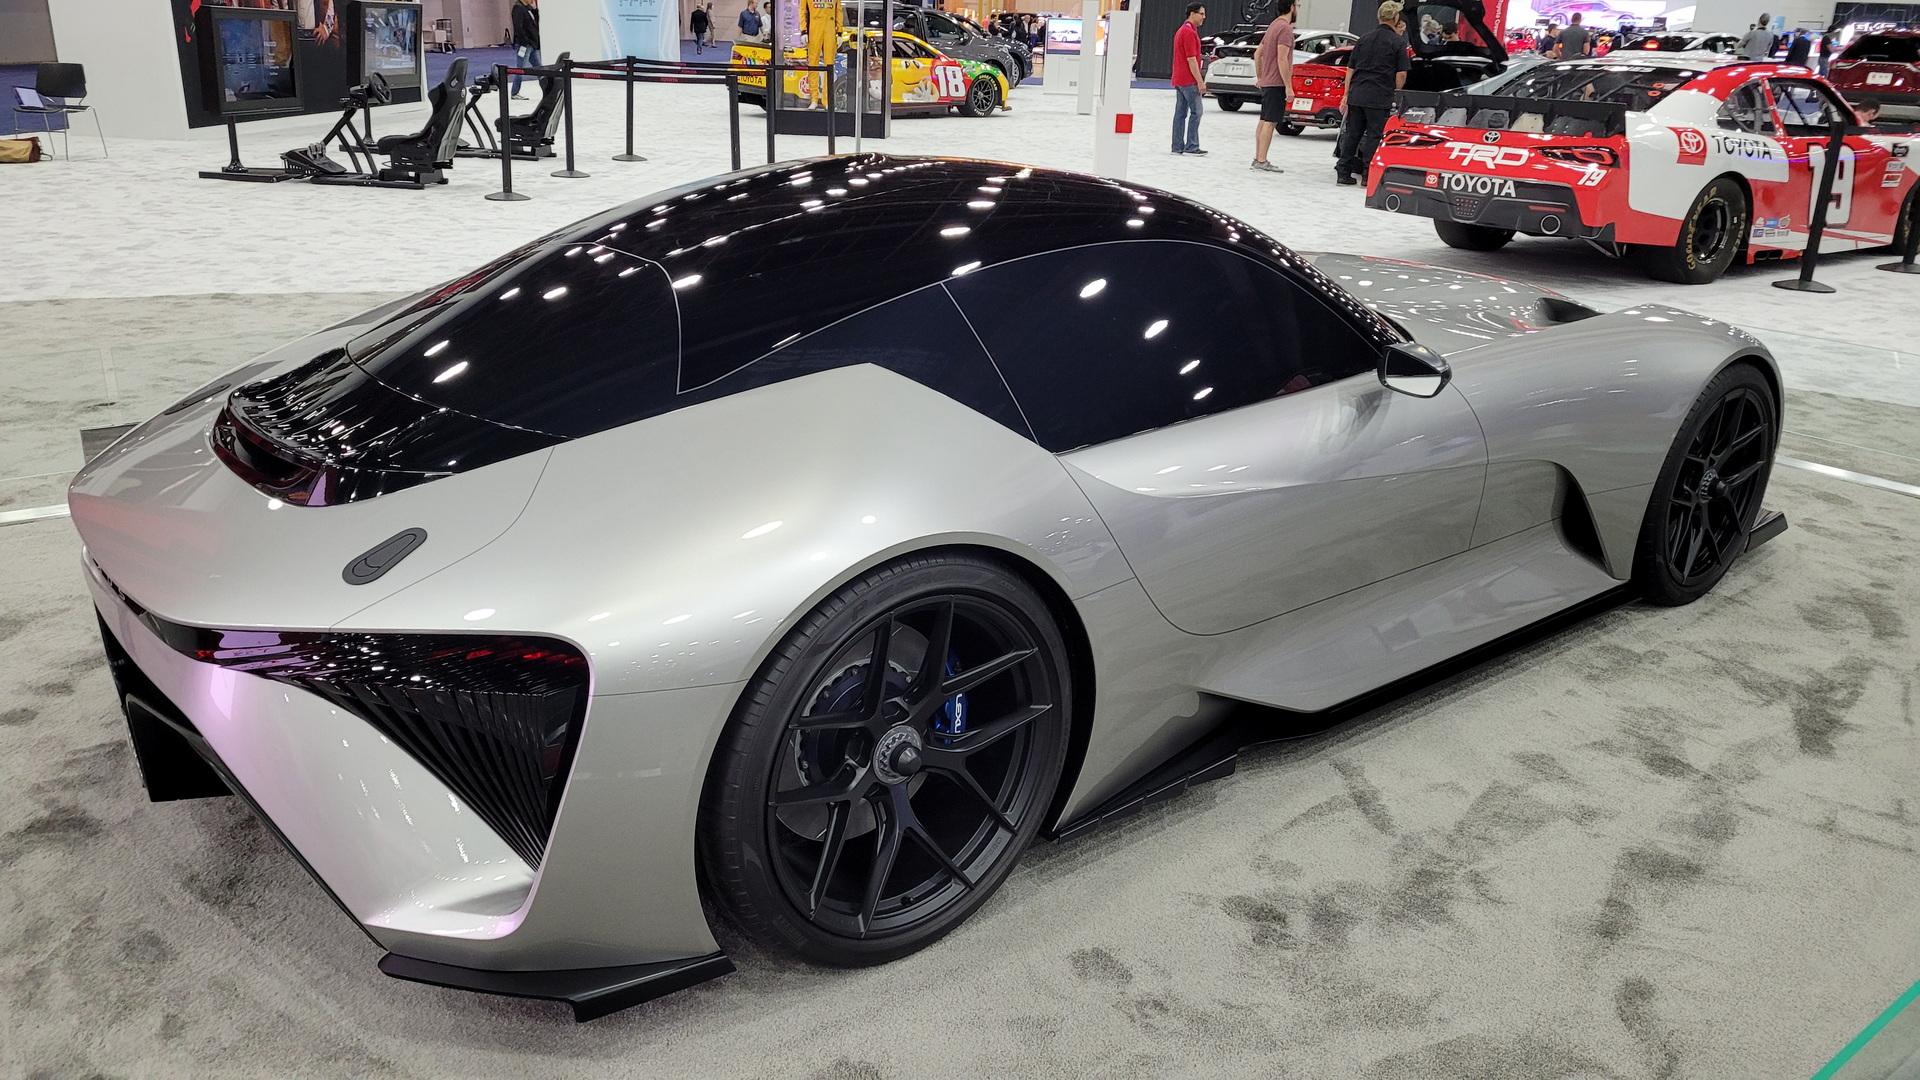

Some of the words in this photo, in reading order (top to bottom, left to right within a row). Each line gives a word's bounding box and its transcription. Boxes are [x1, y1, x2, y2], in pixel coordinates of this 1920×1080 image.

[935, 66, 966, 97] 18
[1444, 142, 1530, 170] TRD
[1711, 134, 1773, 160] TOYOTA
[1441, 173, 1517, 197] TOYOTA
[954, 693, 963, 734] LEXU
